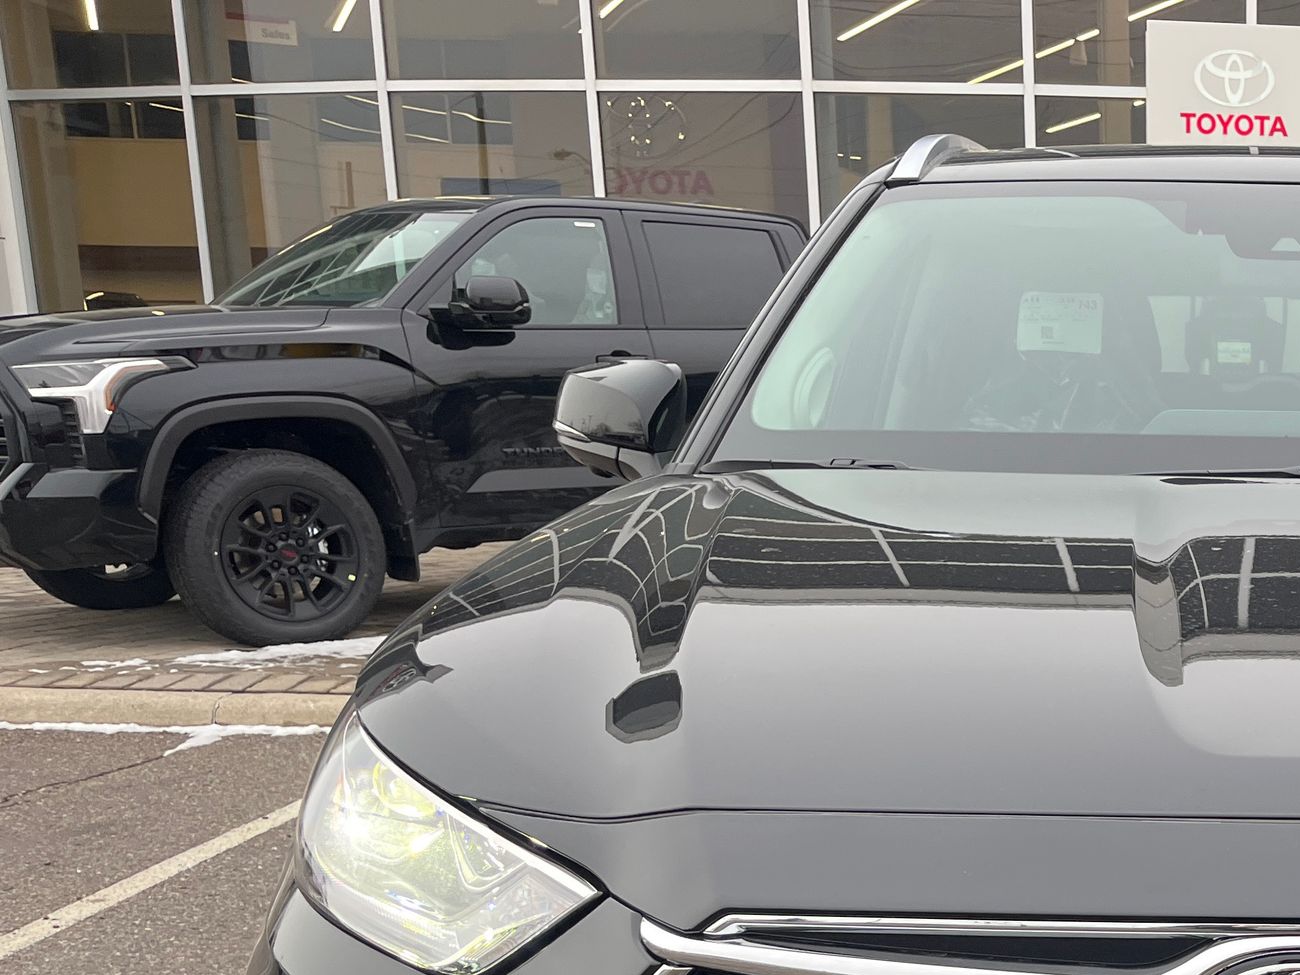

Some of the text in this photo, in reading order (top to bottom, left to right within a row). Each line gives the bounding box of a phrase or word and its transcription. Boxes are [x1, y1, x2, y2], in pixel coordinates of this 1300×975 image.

[1180, 112, 1288, 137] TOYOTA
[615, 167, 714, 196] YOTA
[502, 447, 564, 457] TUNDR
